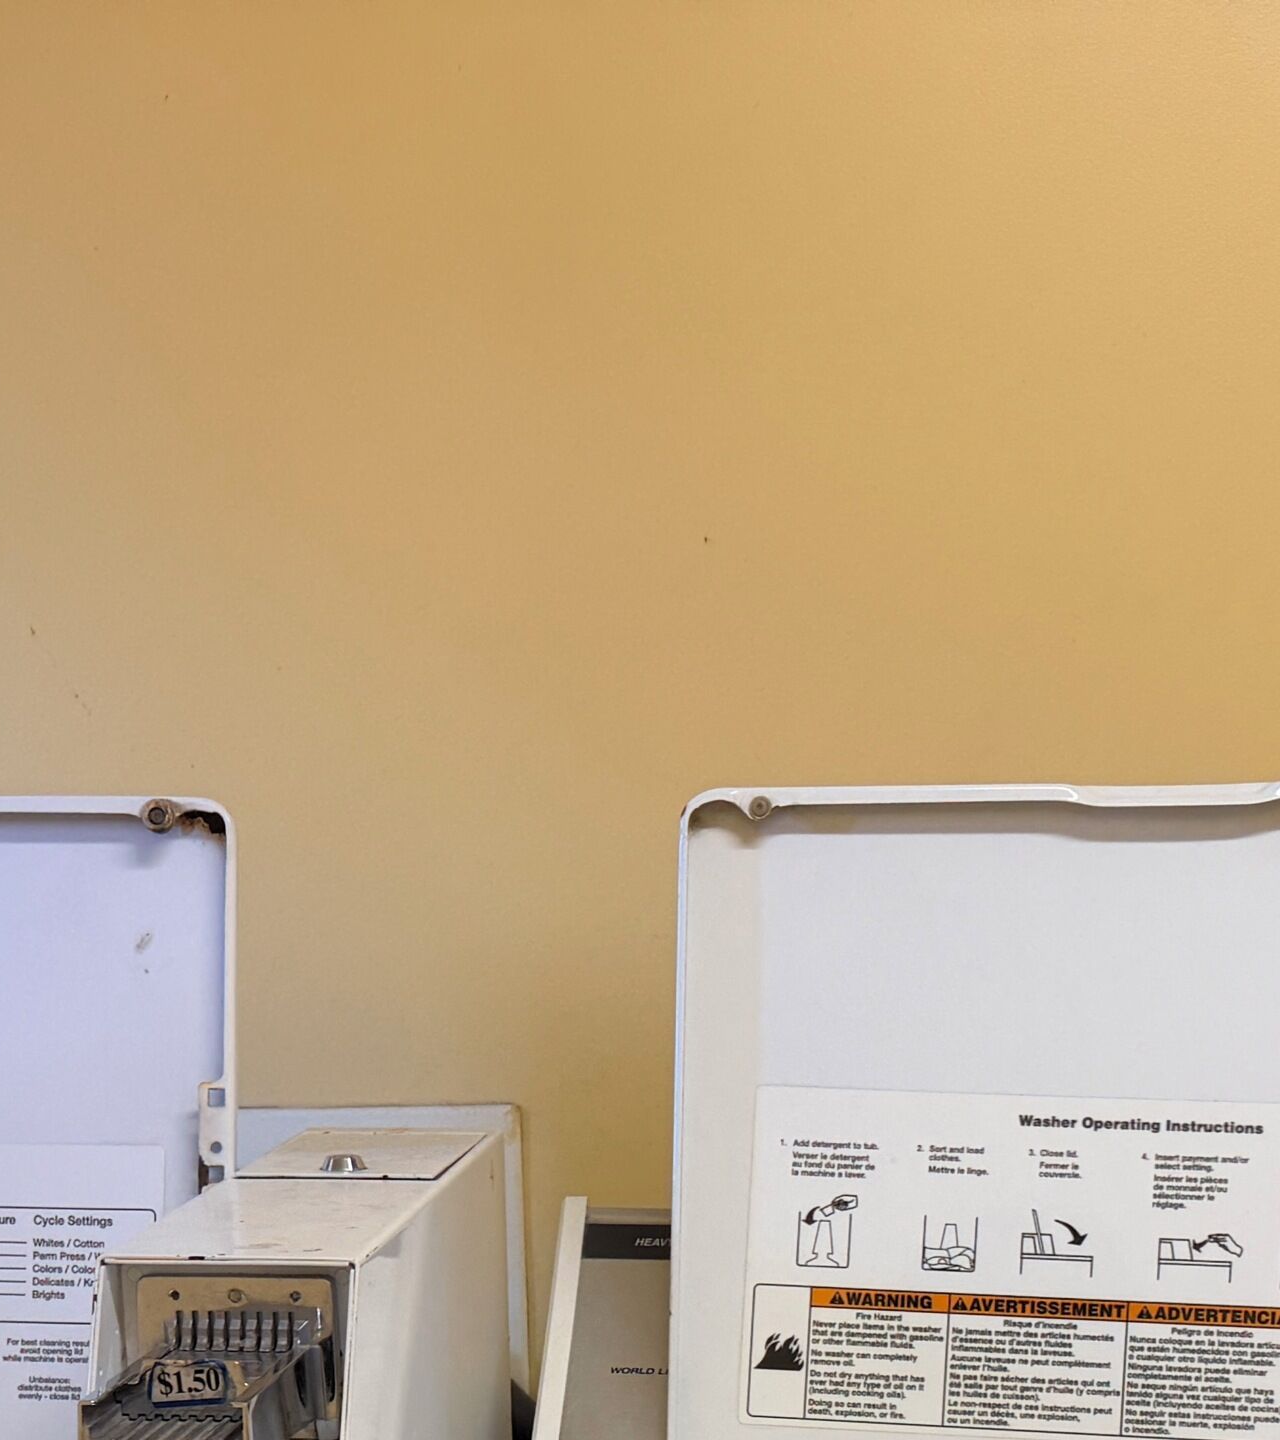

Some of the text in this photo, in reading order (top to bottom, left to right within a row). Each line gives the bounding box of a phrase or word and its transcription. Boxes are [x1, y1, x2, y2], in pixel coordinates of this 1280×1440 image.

[1019, 1115, 1264, 1134] Washer Operating Instructions
[811, 1141, 851, 1150] detergent
[863, 1142, 879, 1150] tub.
[948, 1146, 964, 1154] and
[929, 1154, 961, 1162] clothes.
[1181, 1155, 1219, 1165] payment
[1220, 1156, 1249, 1164] and/or
[1039, 1162, 1069, 1170] Fermer
[1182, 1164, 1214, 1173] setting.
[928, 1166, 955, 1174] Mettre
[966, 1168, 990, 1177] linge.
[33, 1216, 113, 1229] Cycle Settings
[32, 1239, 105, 1248] Whites / Cotton
[32, 1251, 57, 1260] Perm
[61, 1253, 87, 1261] Press
[88, 1253, 93, 1261] /
[32, 1265, 63, 1273] Colors
[64, 1265, 69, 1273] /
[32, 1277, 75, 1286] Delicates
[77, 1278, 81, 1286] /
[32, 1290, 65, 1301] Brights
[846, 1293, 932, 1309] WARNING
[970, 1299, 1125, 1317] AVERTISSEMENT
[873, 1313, 902, 1321] Hazard
[610, 1367, 655, 1375] WORLD
[157, 1367, 221, 1398] $1.50
